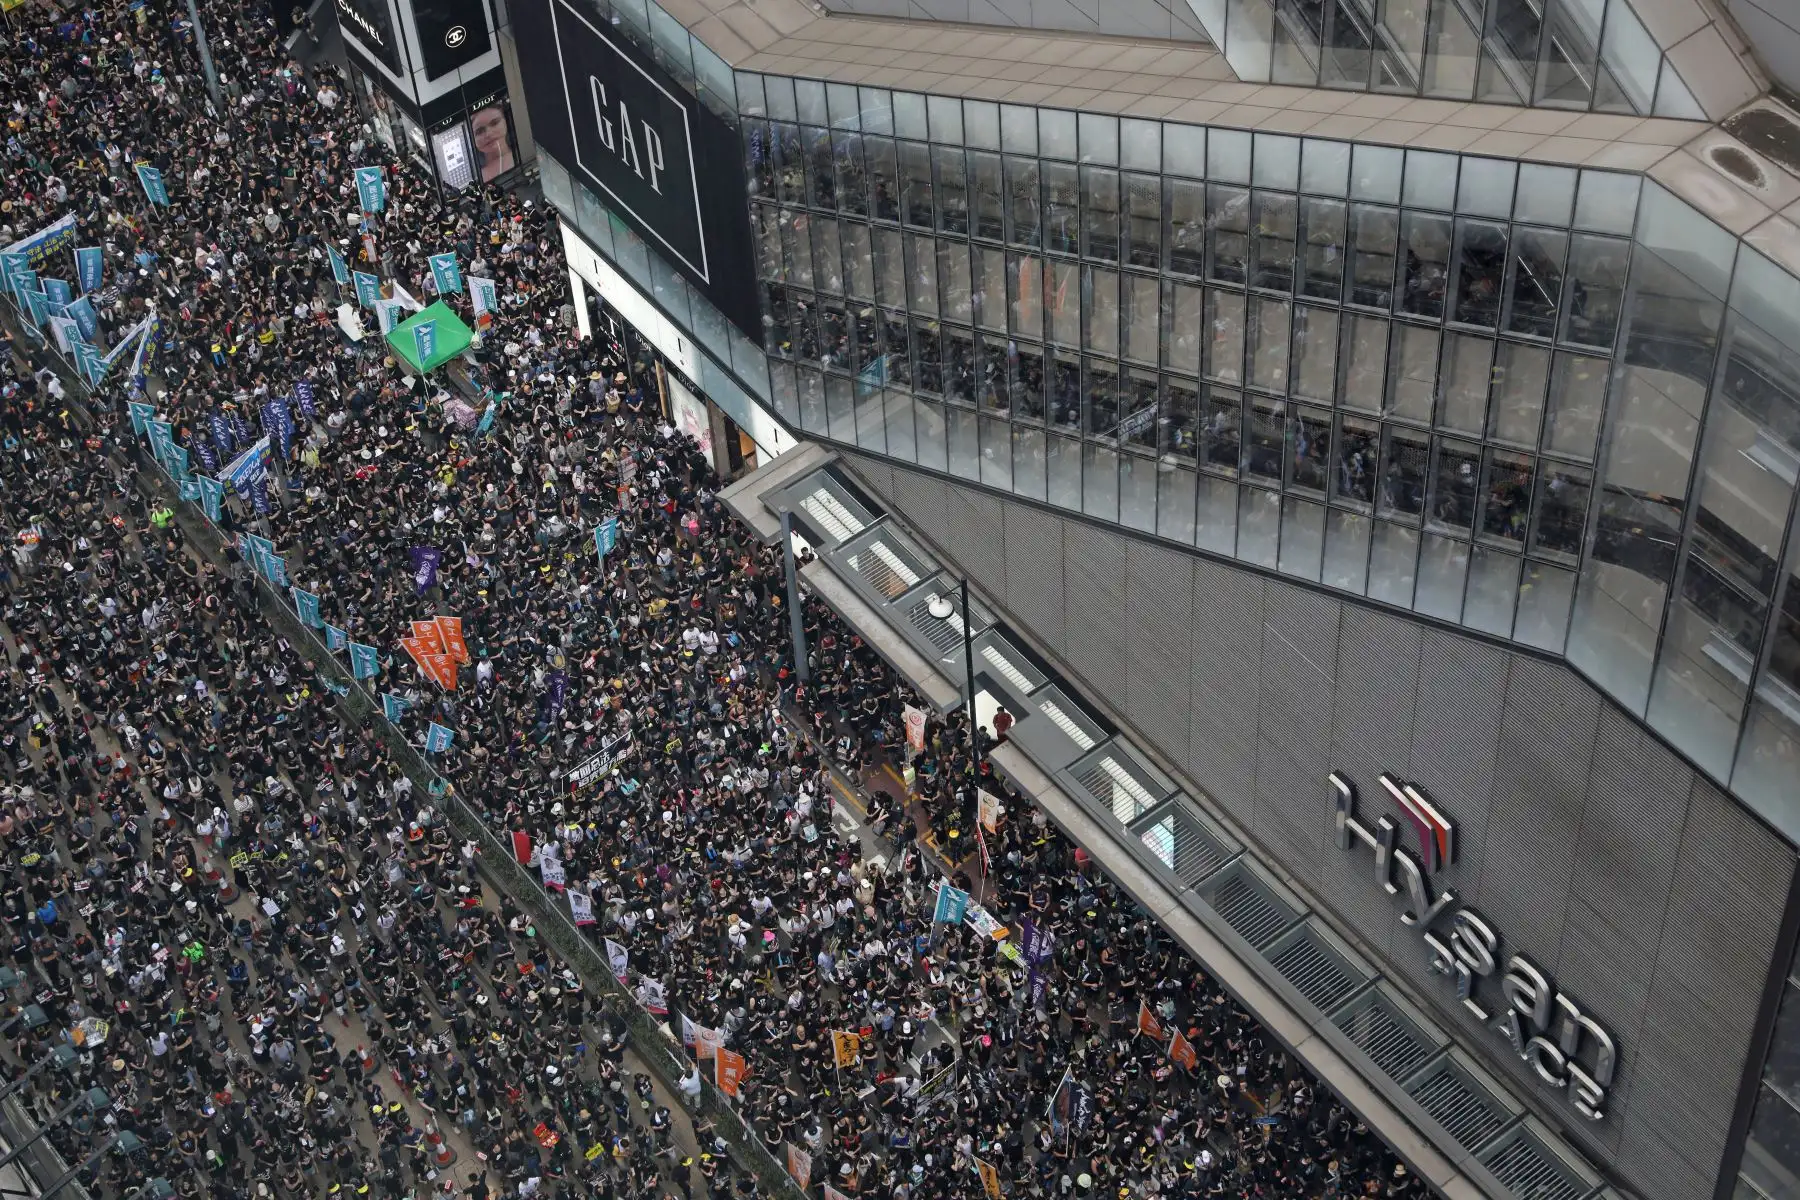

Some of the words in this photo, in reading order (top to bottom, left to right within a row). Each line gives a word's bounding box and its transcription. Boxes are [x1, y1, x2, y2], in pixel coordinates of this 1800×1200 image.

[338, 0, 384, 46] CHANEL
[589, 74, 665, 196] GAP
[1328, 769, 1618, 1088] Hysan
[1424, 930, 1605, 1120] PLACE
